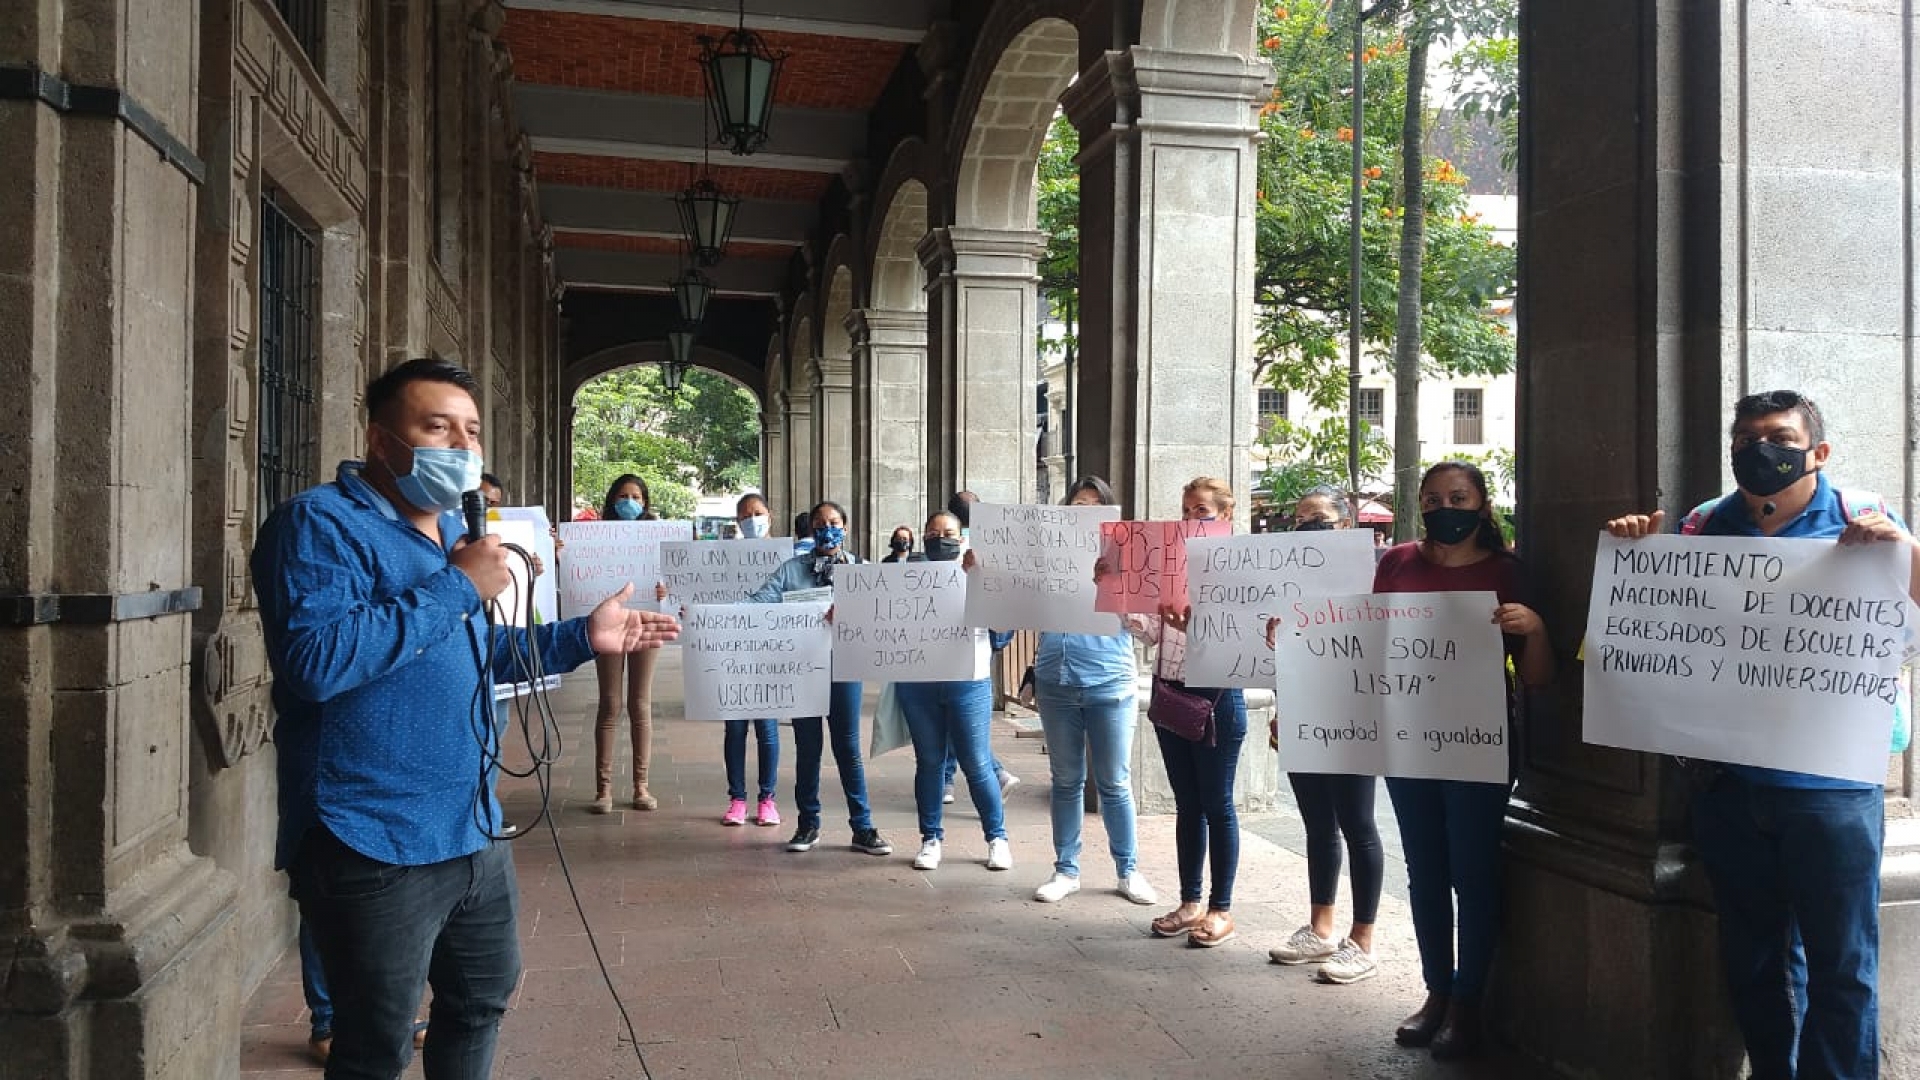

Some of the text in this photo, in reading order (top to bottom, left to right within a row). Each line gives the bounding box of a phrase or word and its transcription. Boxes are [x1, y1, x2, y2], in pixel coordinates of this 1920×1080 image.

[1026, 526, 1069, 548] SOLA
[665, 551, 783, 568] POR UNA LUCHA
[982, 552, 1000, 569] LA
[1202, 546, 1325, 573] IGUALDAD
[1613, 548, 1783, 583] MOVIMIENTO
[665, 573, 701, 588] JUSTA
[713, 572, 728, 583] EN
[738, 572, 750, 583] EL
[847, 569, 961, 593] UNA SOLA
[983, 576, 1079, 594] ES PRIMERO
[669, 593, 686, 606] DE
[1199, 582, 1302, 605] EQUIDAD
[1610, 578, 1905, 627] NACIONAL DE DOCENTES
[695, 609, 826, 630] NORMAL SUPERIOR
[874, 596, 938, 621] LISTA
[1293, 599, 1435, 628] Solicitamos
[838, 622, 970, 645] POR UNA LUCHA
[1193, 611, 1242, 644] UNA
[1605, 616, 1896, 658] EGRESADOS DE ESCUELAS
[698, 638, 795, 652] UNIVERSIDADES
[1389, 636, 1458, 661] SOLA
[721, 658, 814, 676] PARTICULARES
[874, 648, 927, 667] JUSTA
[1600, 644, 1900, 705] PRIVADAS Y UNIVERSIDADES
[718, 683, 796, 706] USICAMM
[1297, 720, 1504, 753] Equidad e igualdad
